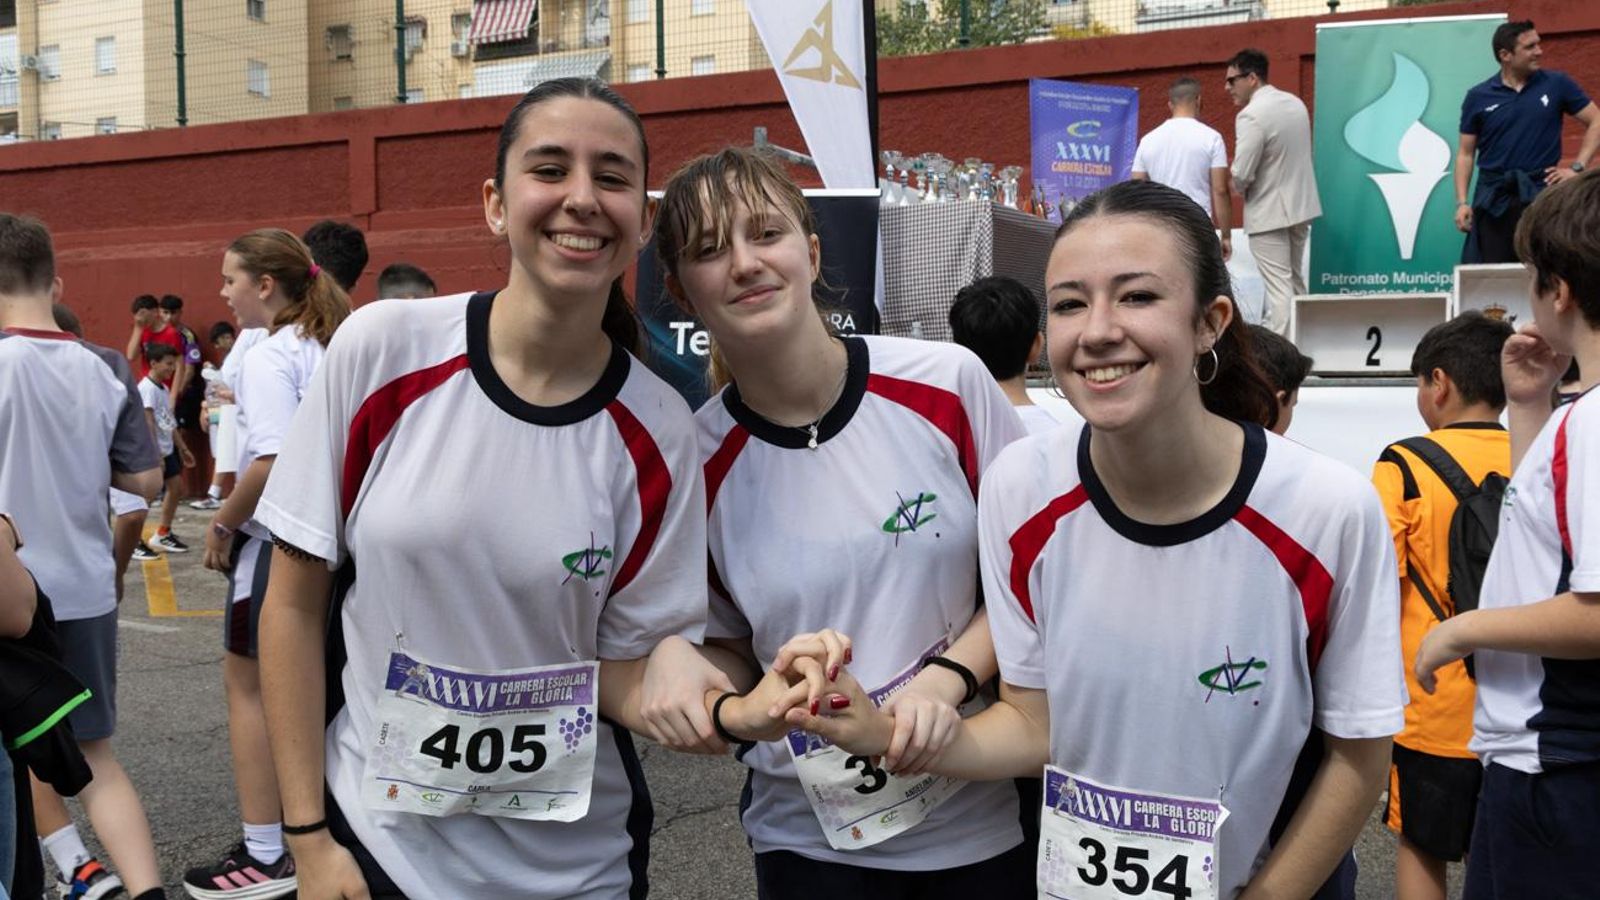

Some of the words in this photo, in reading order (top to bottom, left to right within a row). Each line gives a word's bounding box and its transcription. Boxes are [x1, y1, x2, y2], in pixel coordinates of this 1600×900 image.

[1056, 141, 1111, 162] XXXVI
[1321, 272, 1389, 285] Patronato
[669, 321, 710, 356] Te
[1365, 326, 1382, 366] 2
[425, 672, 497, 709] XXXVI
[500, 677, 545, 694] CARRERA
[547, 673, 587, 689] ESCOLAR
[505, 693, 521, 706] LA
[531, 686, 574, 705] GLORIA
[419, 724, 548, 774] 405
[1072, 786, 1132, 826] XXXVI
[1134, 800, 1184, 819] CARRERA
[1144, 814, 1160, 830] LA
[1077, 837, 1192, 900] 354
